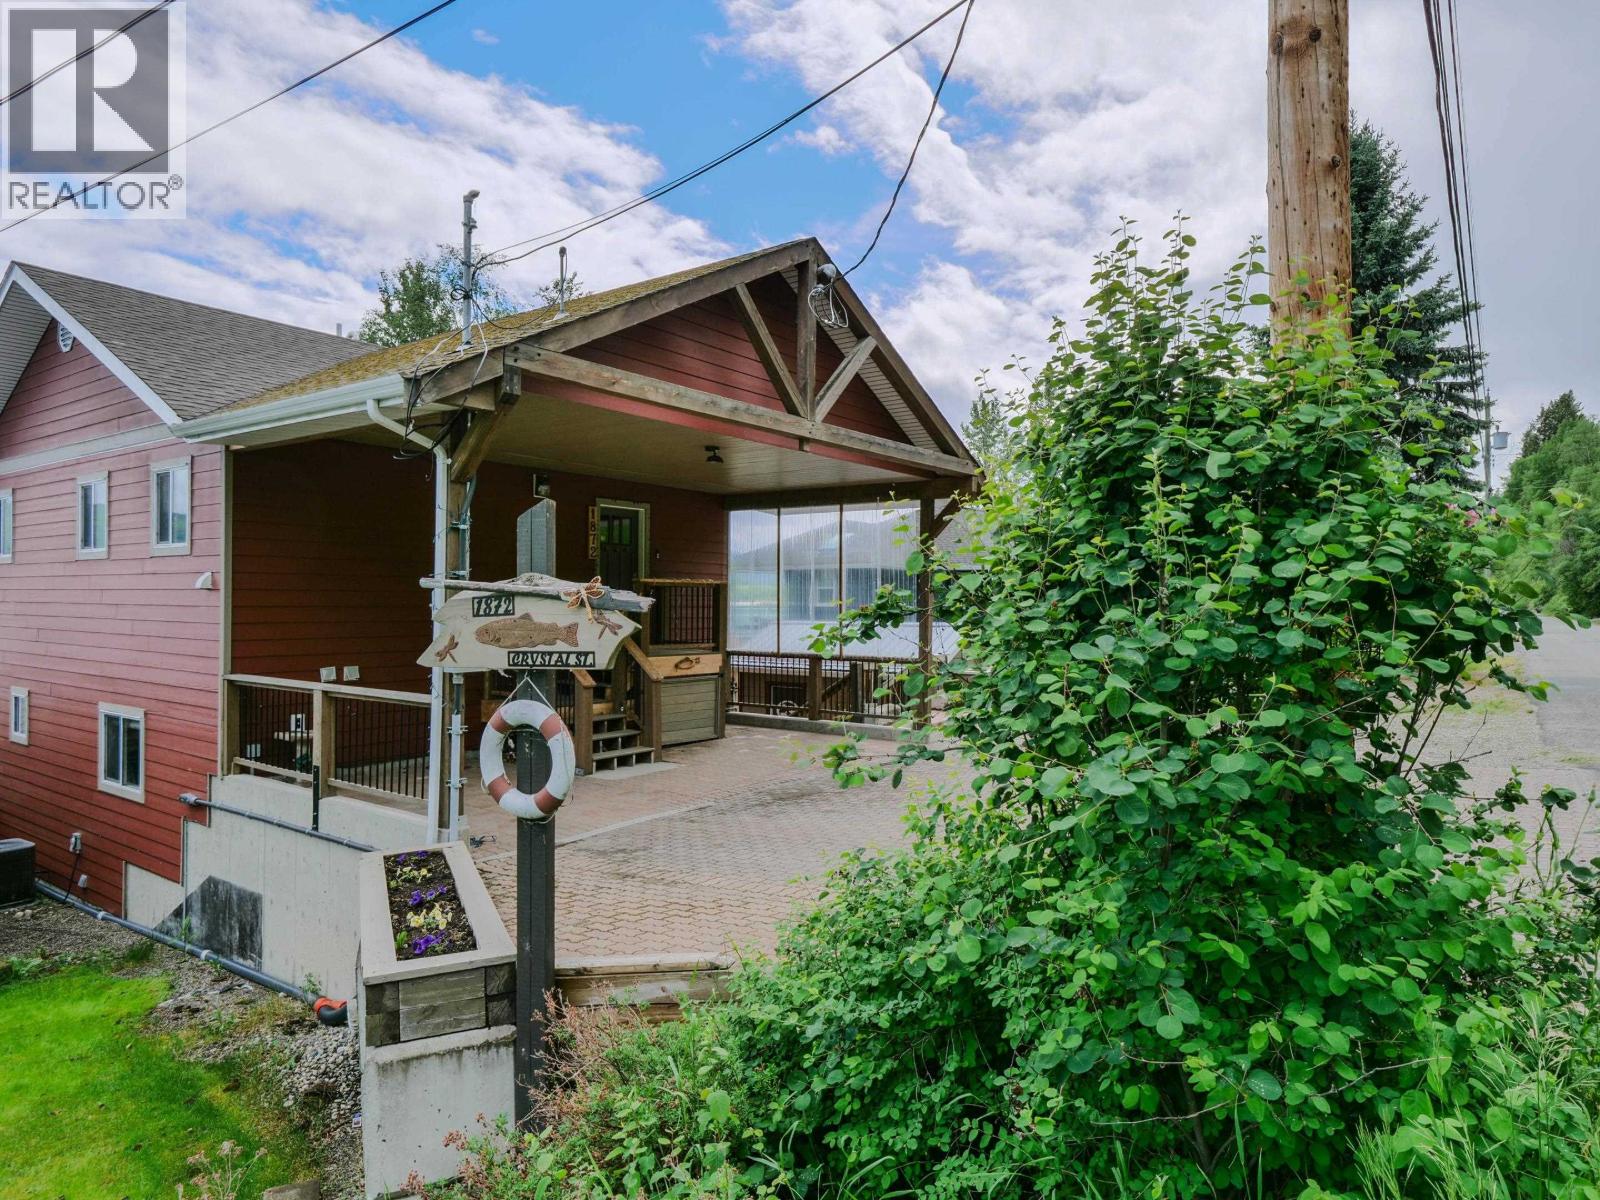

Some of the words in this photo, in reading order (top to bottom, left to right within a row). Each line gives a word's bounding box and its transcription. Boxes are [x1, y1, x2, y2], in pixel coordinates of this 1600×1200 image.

[589, 506, 597, 558] 1872
[474, 596, 513, 616] 1872
[511, 652, 571, 668] CRYSTAL
